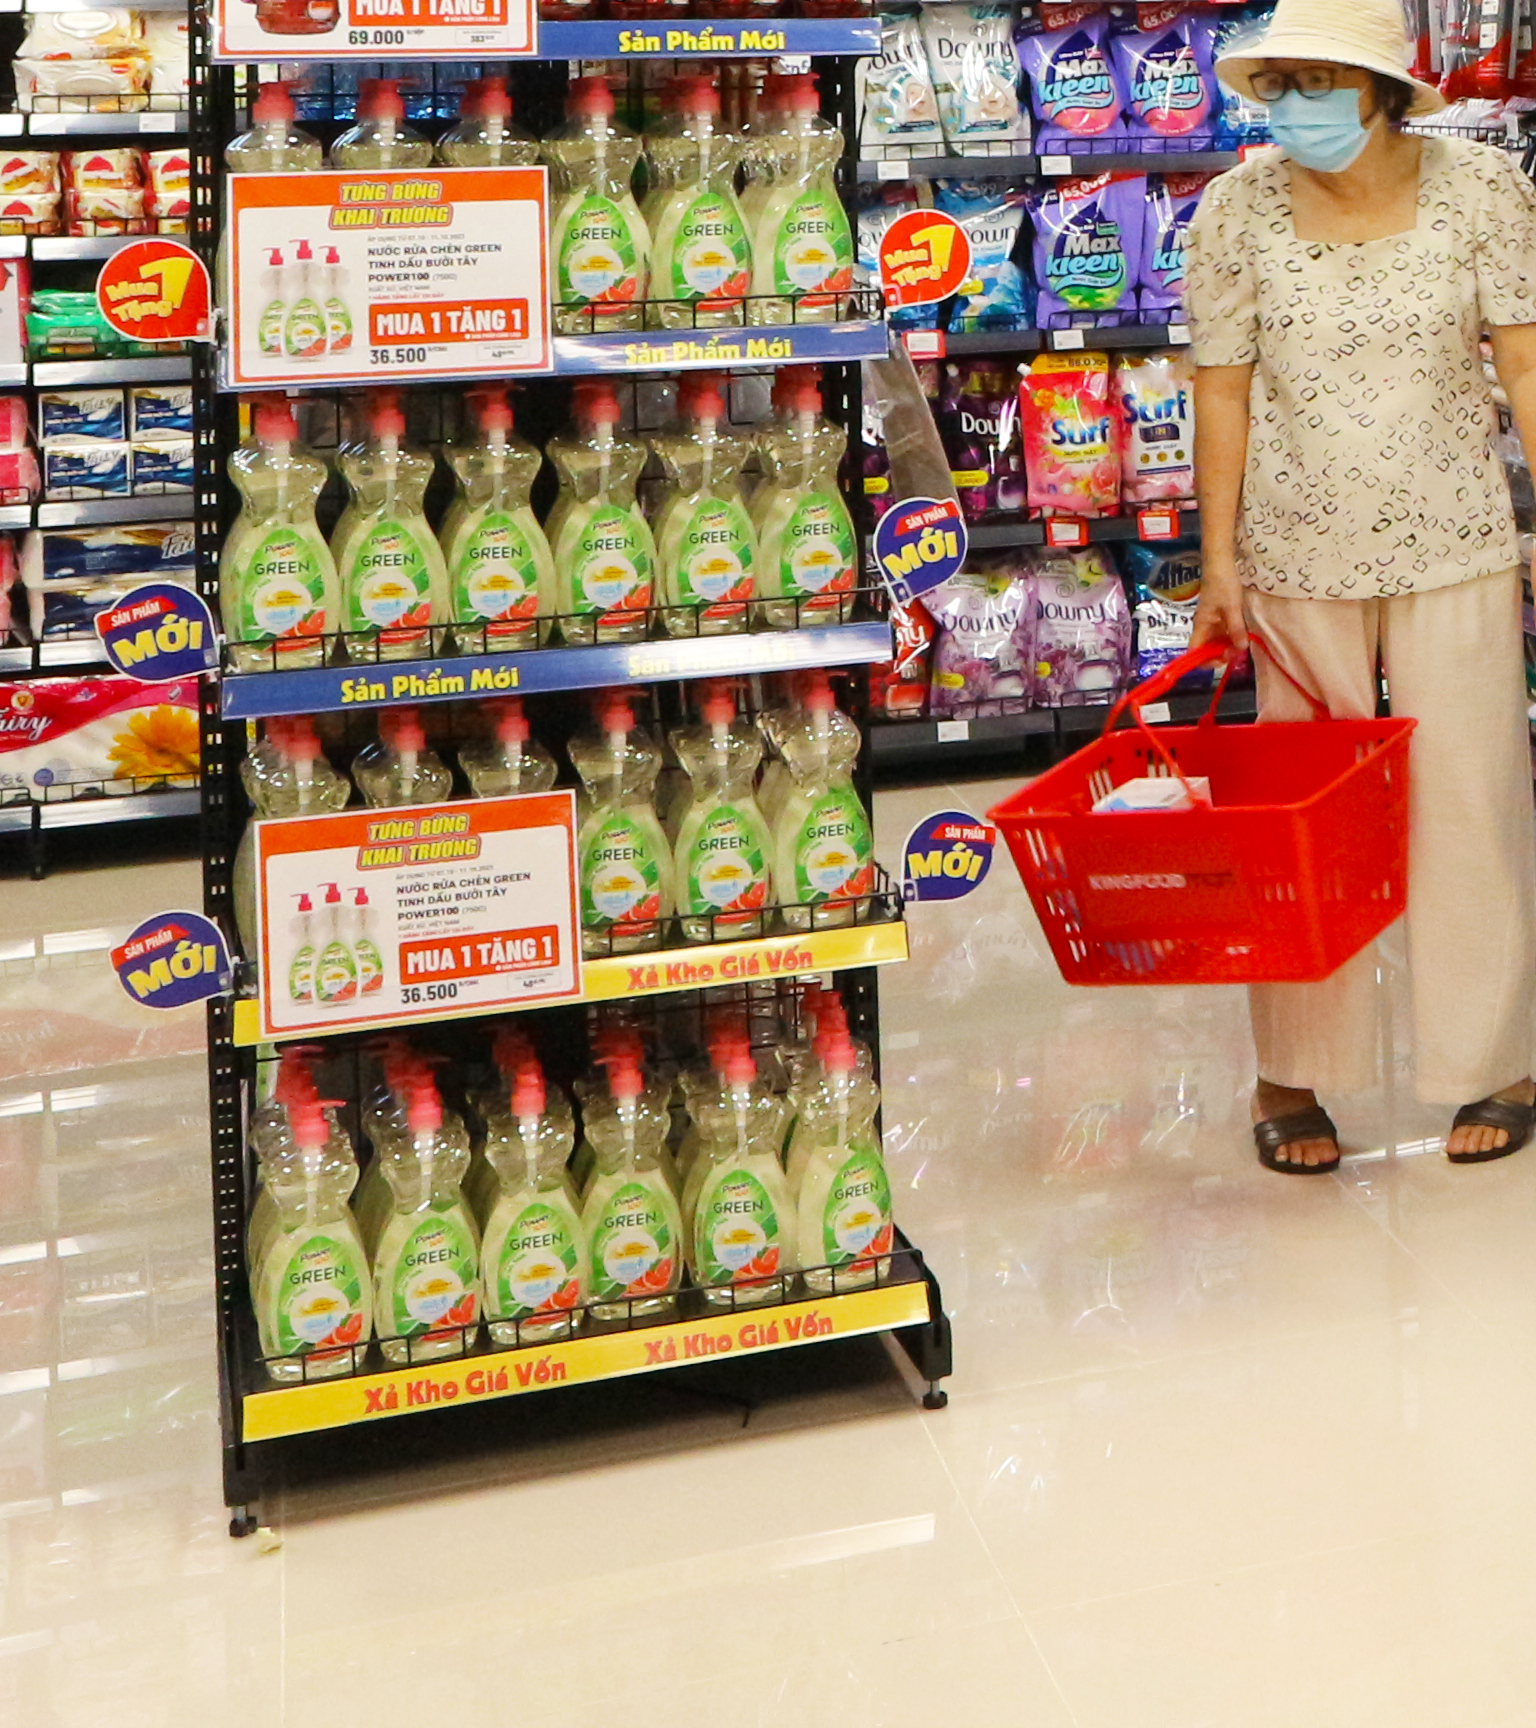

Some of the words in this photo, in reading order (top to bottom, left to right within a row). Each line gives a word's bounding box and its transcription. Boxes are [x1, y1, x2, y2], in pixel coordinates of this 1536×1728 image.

[619, 29, 660, 52] Sản
[666, 26, 734, 51] Phẩm
[739, 29, 786, 49] Mới
[570, 224, 623, 240] GREEN
[683, 221, 734, 236] GREEN
[377, 313, 425, 336] MUA
[431, 312, 441, 333] 1
[446, 306, 506, 333] TẶNG
[511, 308, 521, 330] 1
[370, 347, 426, 365] 36.500
[1051, 417, 1110, 446] Surf
[341, 676, 386, 705] Sản
[394, 670, 464, 700] Phẩm
[470, 666, 519, 694] Mới
[908, 844, 984, 882] MỚI
[626, 964, 659, 991] Xả
[665, 961, 713, 987] Kho
[719, 953, 761, 979] Giá
[766, 948, 813, 972] Vốn
[834, 1180, 879, 1200] GREEN
